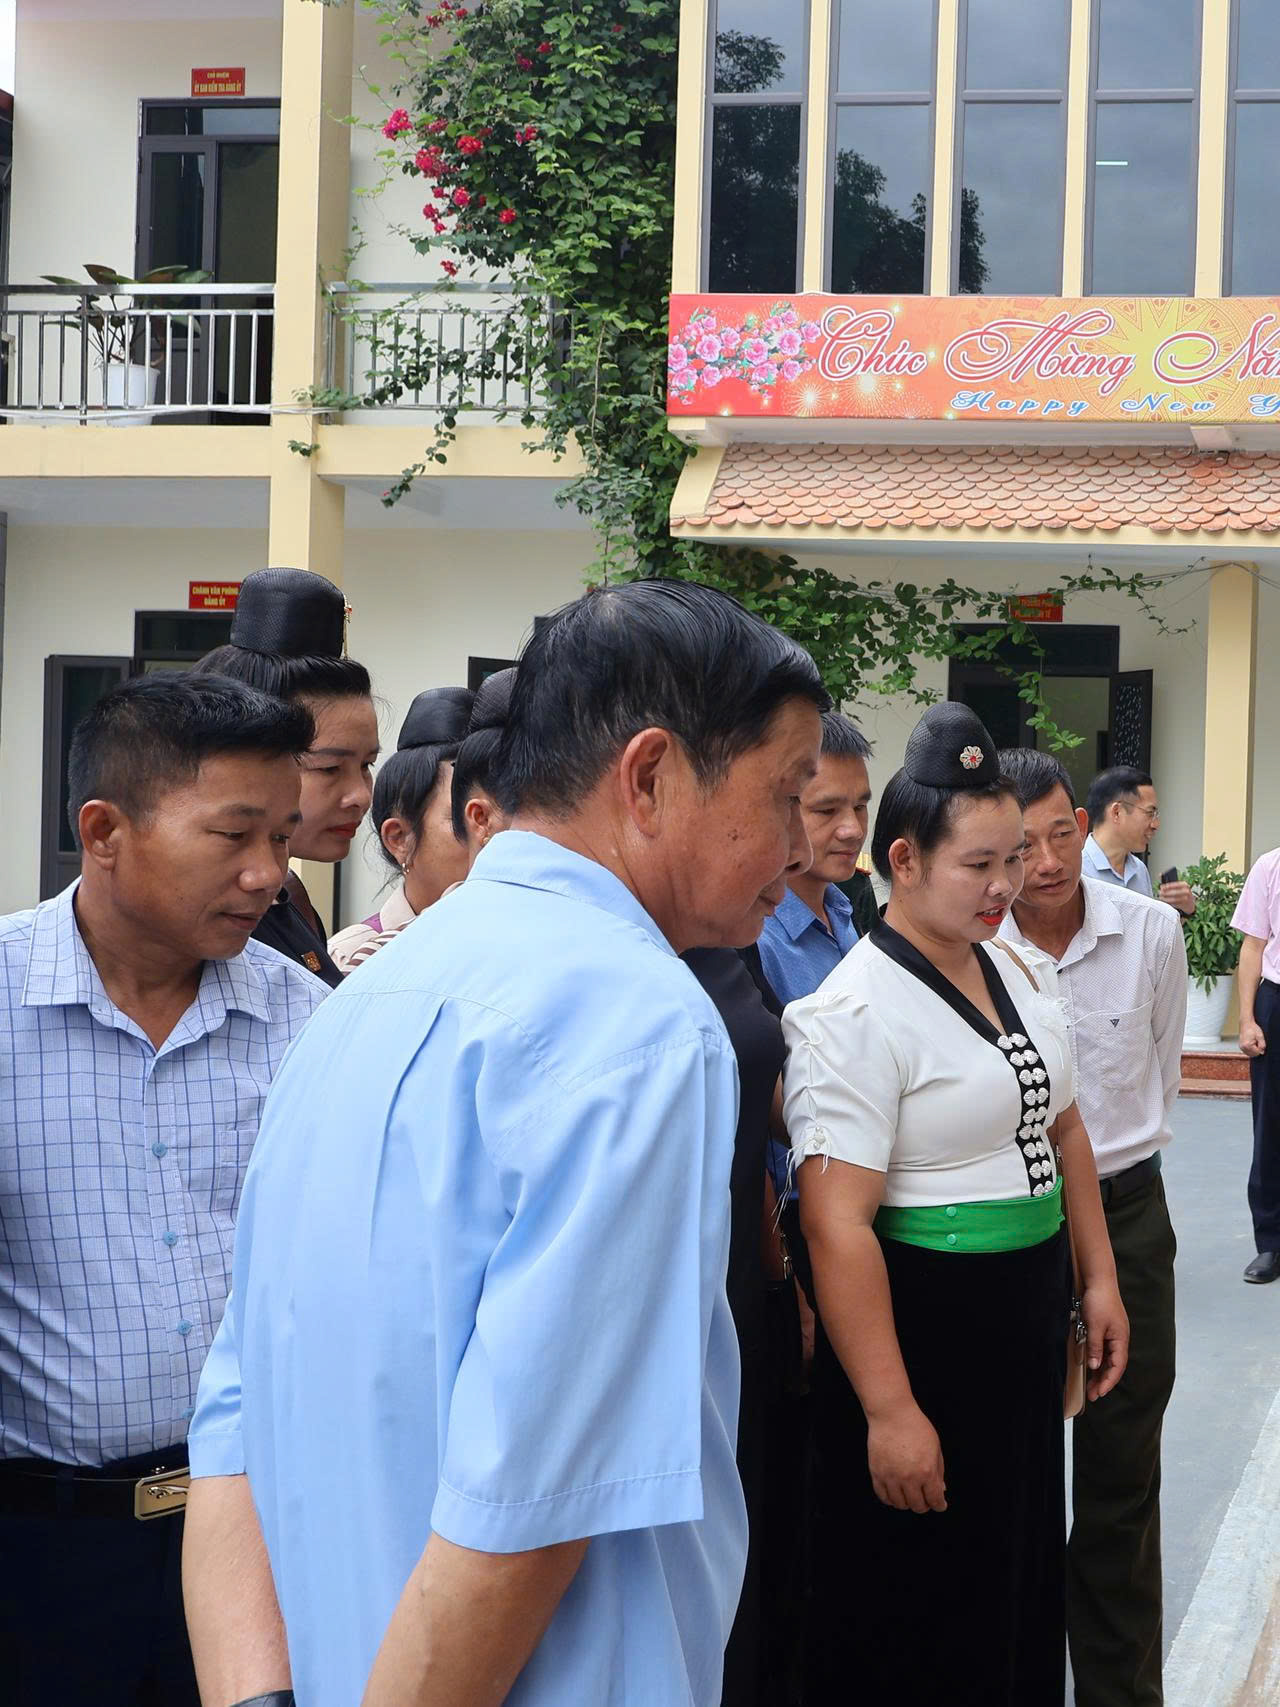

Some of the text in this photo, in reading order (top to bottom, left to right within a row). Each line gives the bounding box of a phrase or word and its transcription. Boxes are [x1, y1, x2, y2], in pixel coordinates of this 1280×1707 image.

[818, 304, 928, 382] Chúc
[943, 308, 1136, 396] Mừng
[951, 390, 1089, 415] Happy
[1119, 392, 1215, 413] New
